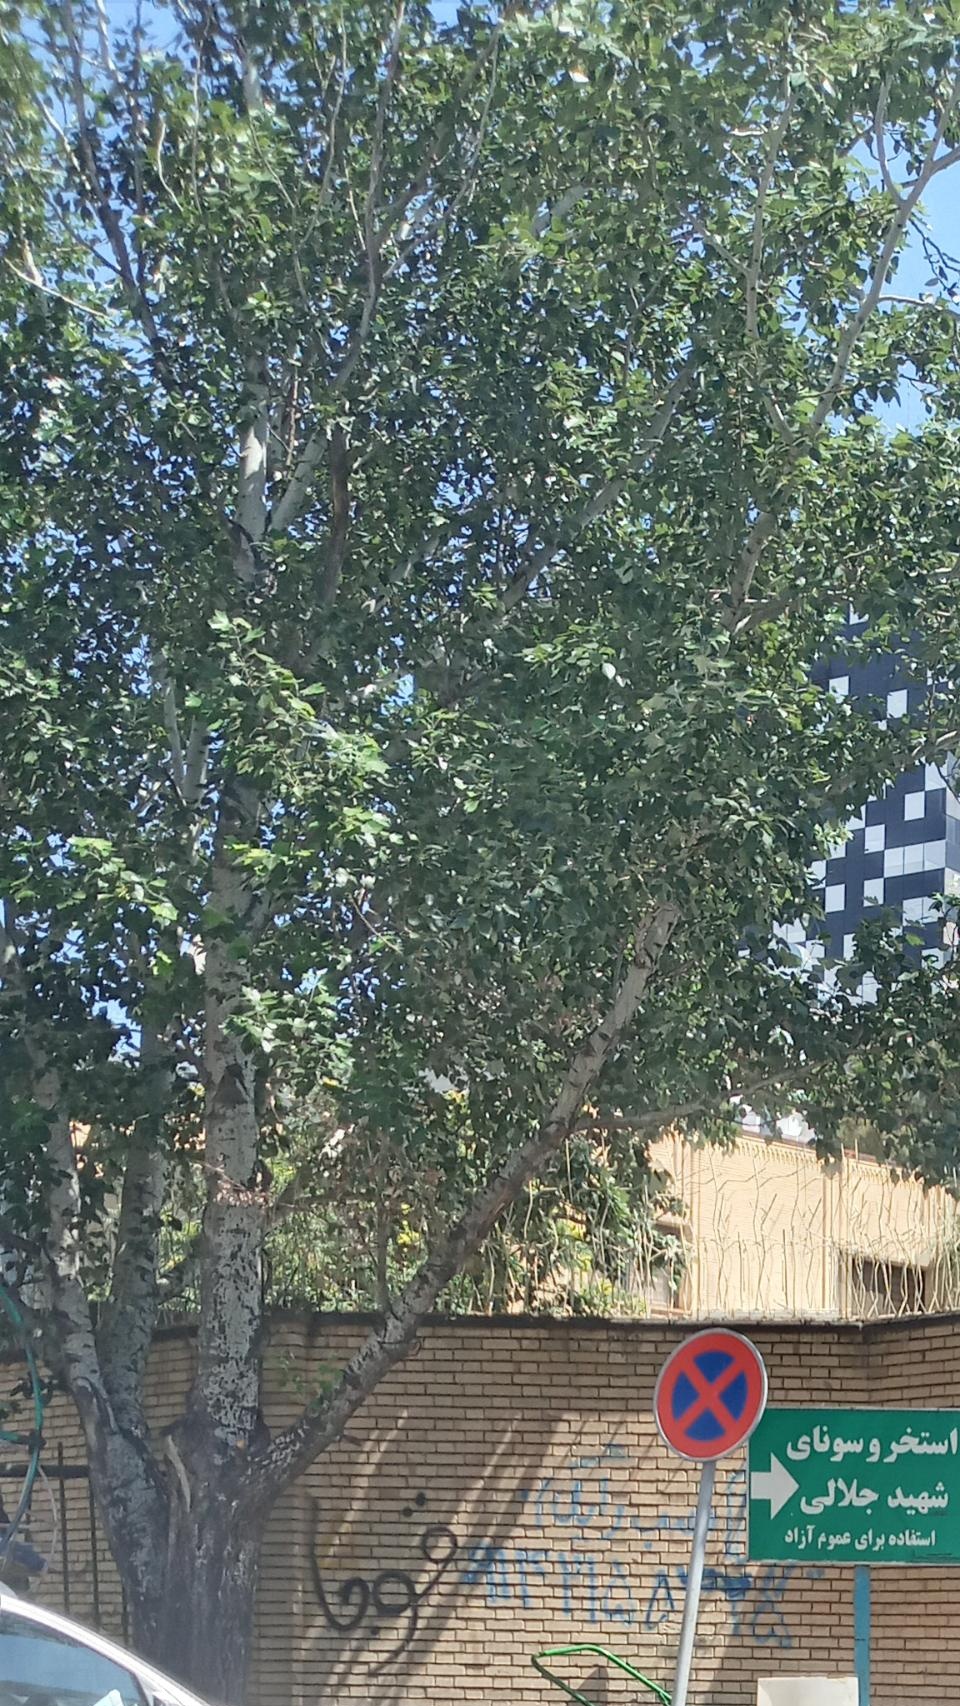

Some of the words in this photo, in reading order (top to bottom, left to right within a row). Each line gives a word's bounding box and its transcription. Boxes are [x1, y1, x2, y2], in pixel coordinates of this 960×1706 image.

[787, 1426, 863, 1461] سونای
[867, 1439, 880, 1462] و
[884, 1428, 957, 1462] استخر
[801, 1478, 878, 1514] جلالی
[888, 1482, 948, 1515] شهید
[785, 1525, 814, 1548] آزاد
[818, 1533, 850, 1549] عموم
[855, 1529, 885, 1550] برای
[889, 1530, 935, 1546] استفاده
